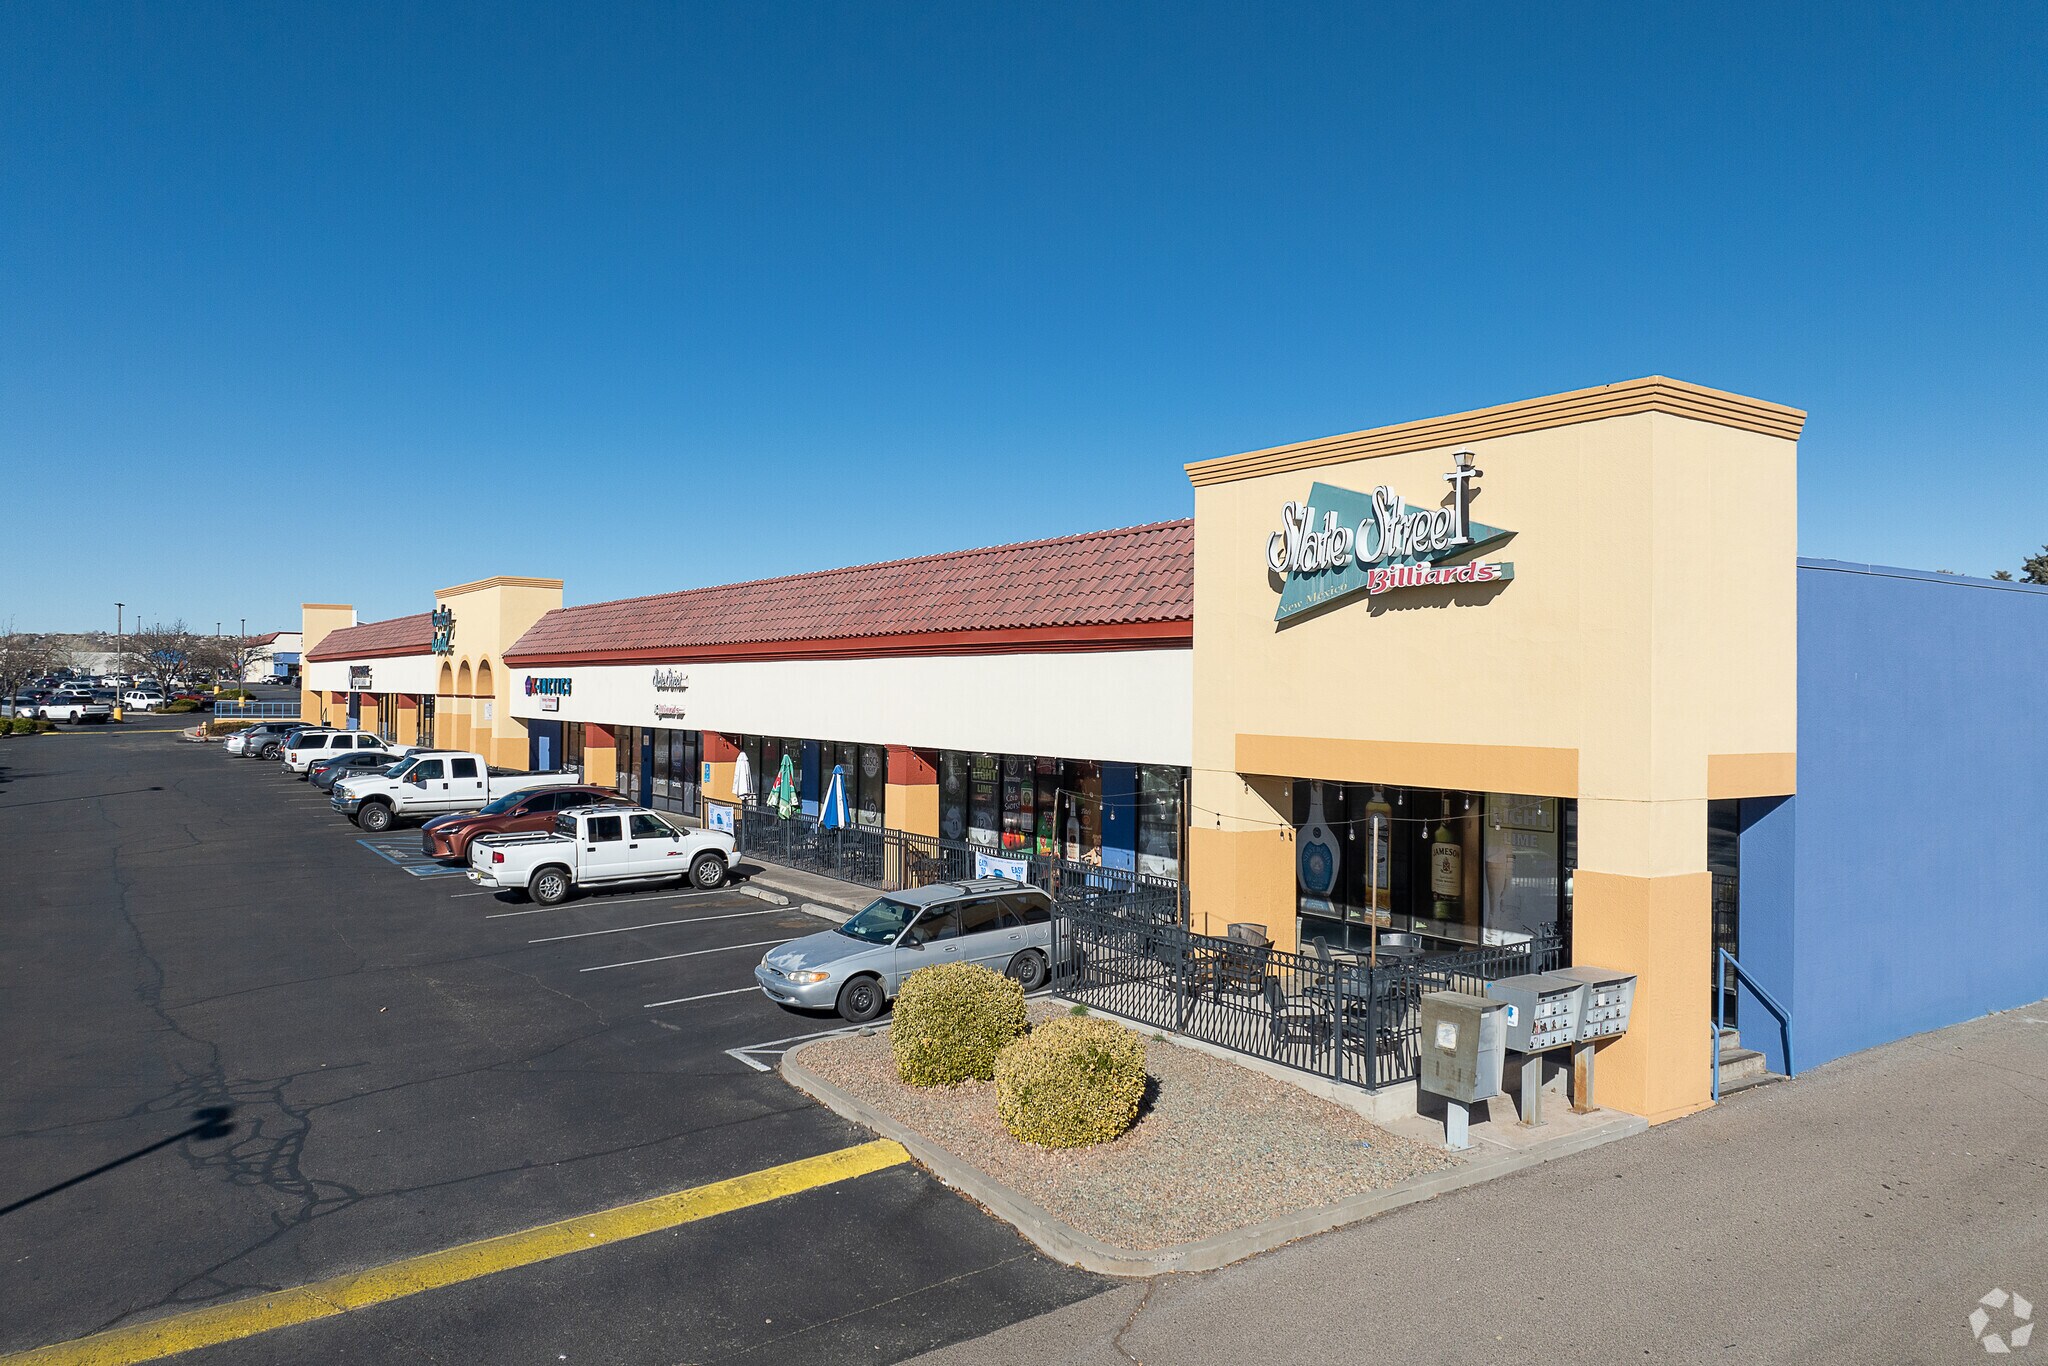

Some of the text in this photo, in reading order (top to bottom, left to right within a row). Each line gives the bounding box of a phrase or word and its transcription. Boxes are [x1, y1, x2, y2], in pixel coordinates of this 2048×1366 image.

[1266, 465, 1476, 573] Slate Street
[1366, 562, 1499, 595] Billiards
[1280, 583, 1348, 613] New Mexico
[976, 756, 994, 768] BUD
[972, 767, 997, 781] LIGHT
[977, 784, 993, 793] LIME
[1503, 833, 1538, 848] LIME
[1432, 847, 1460, 859] JAMESON
